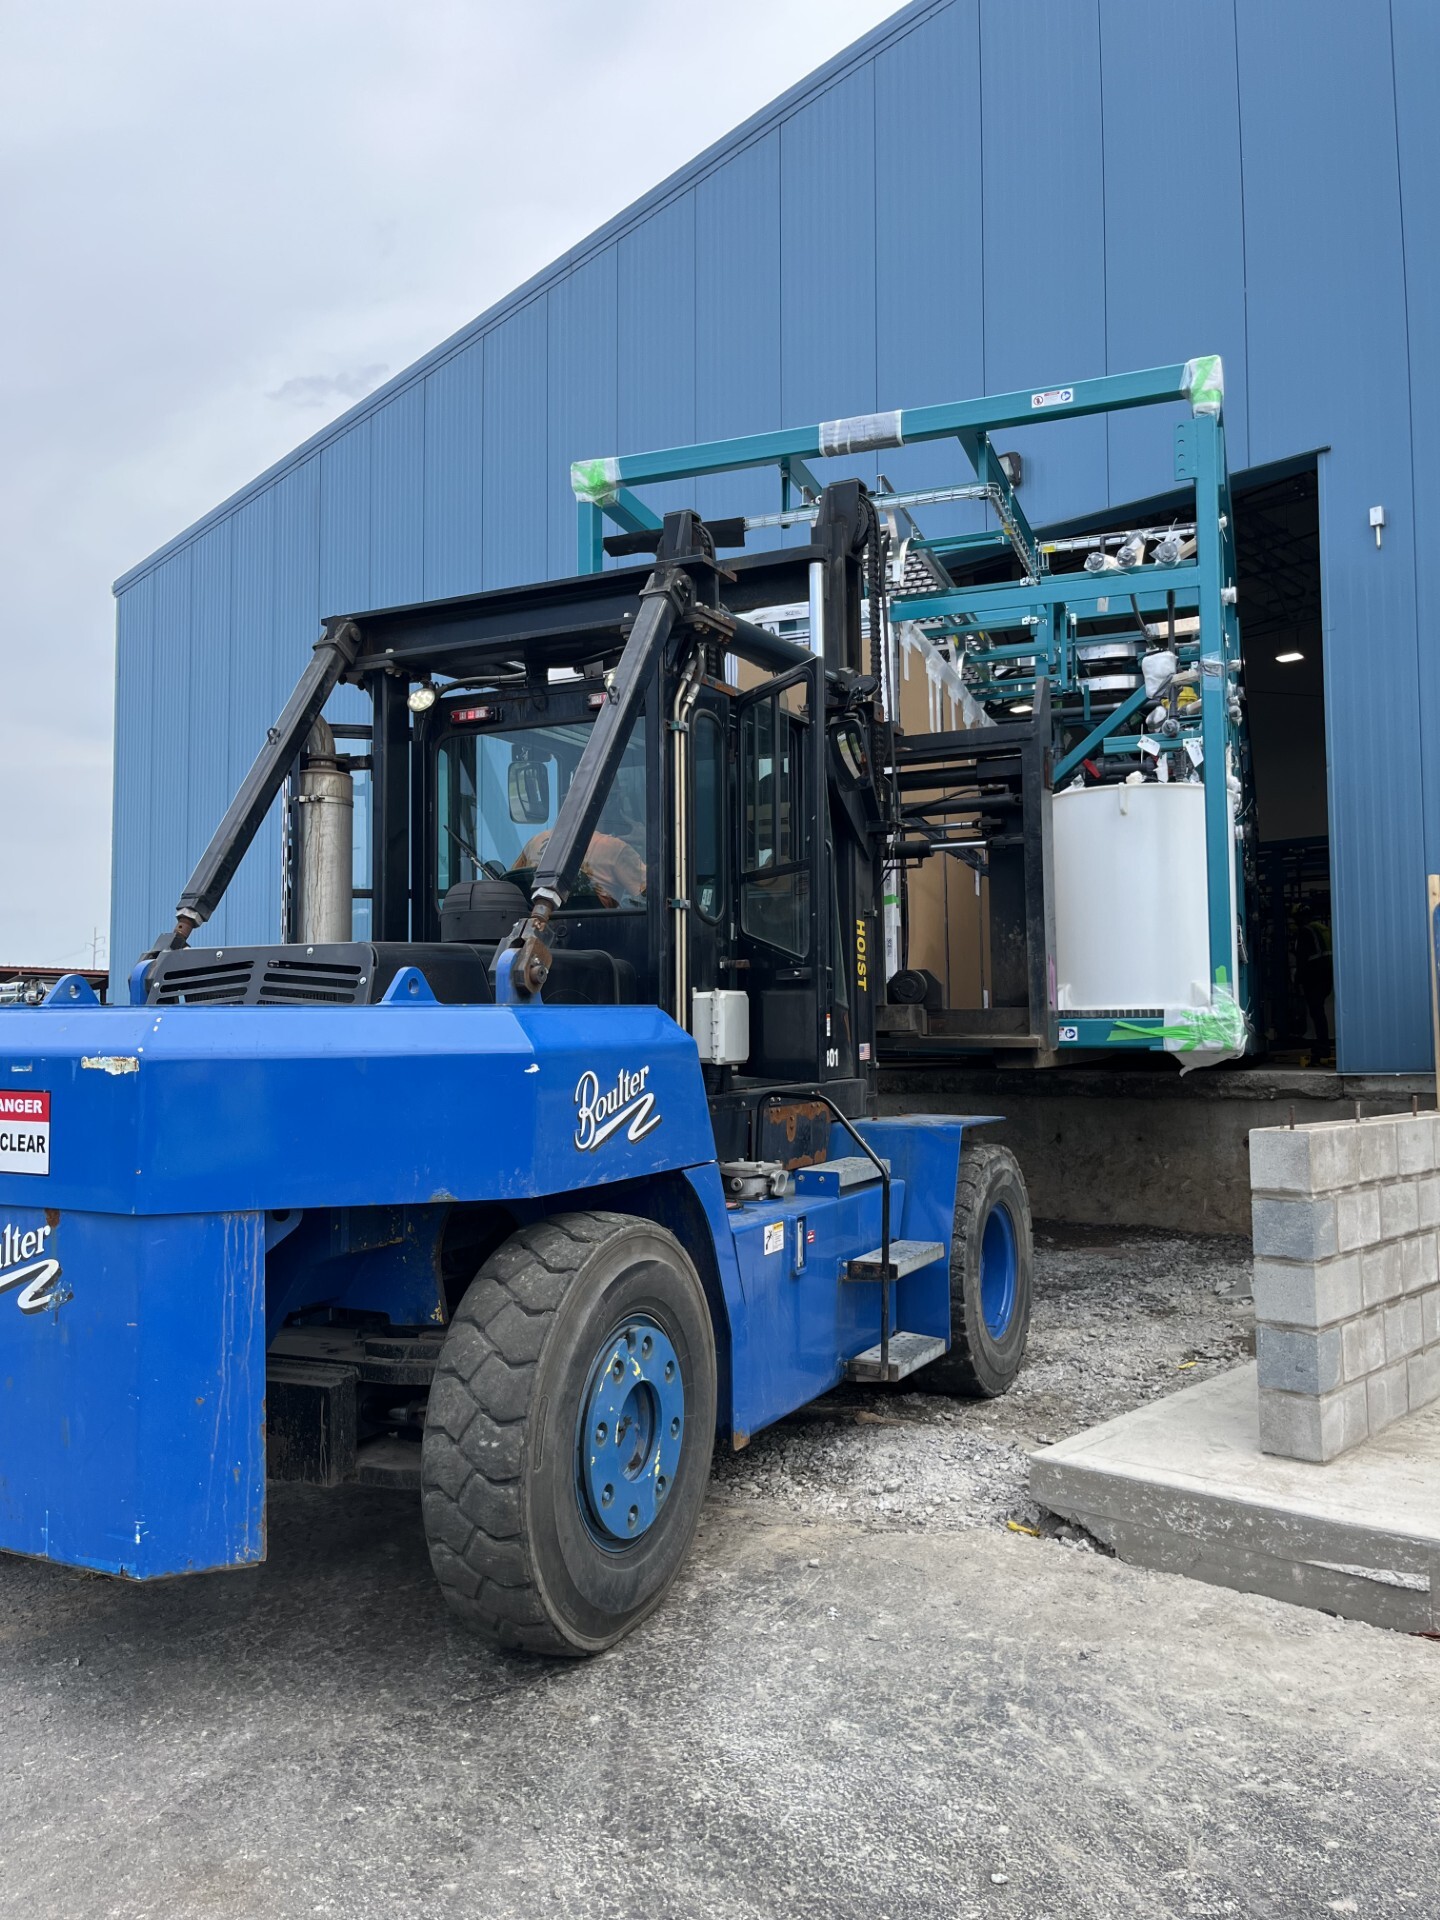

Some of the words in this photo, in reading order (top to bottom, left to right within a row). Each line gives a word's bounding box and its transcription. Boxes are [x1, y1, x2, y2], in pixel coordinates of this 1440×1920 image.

[856, 919, 867, 992] HOIST
[574, 1065, 650, 1149] Boulter
[0, 1132, 46, 1153] CLEAR
[0, 1223, 51, 1269] lter
